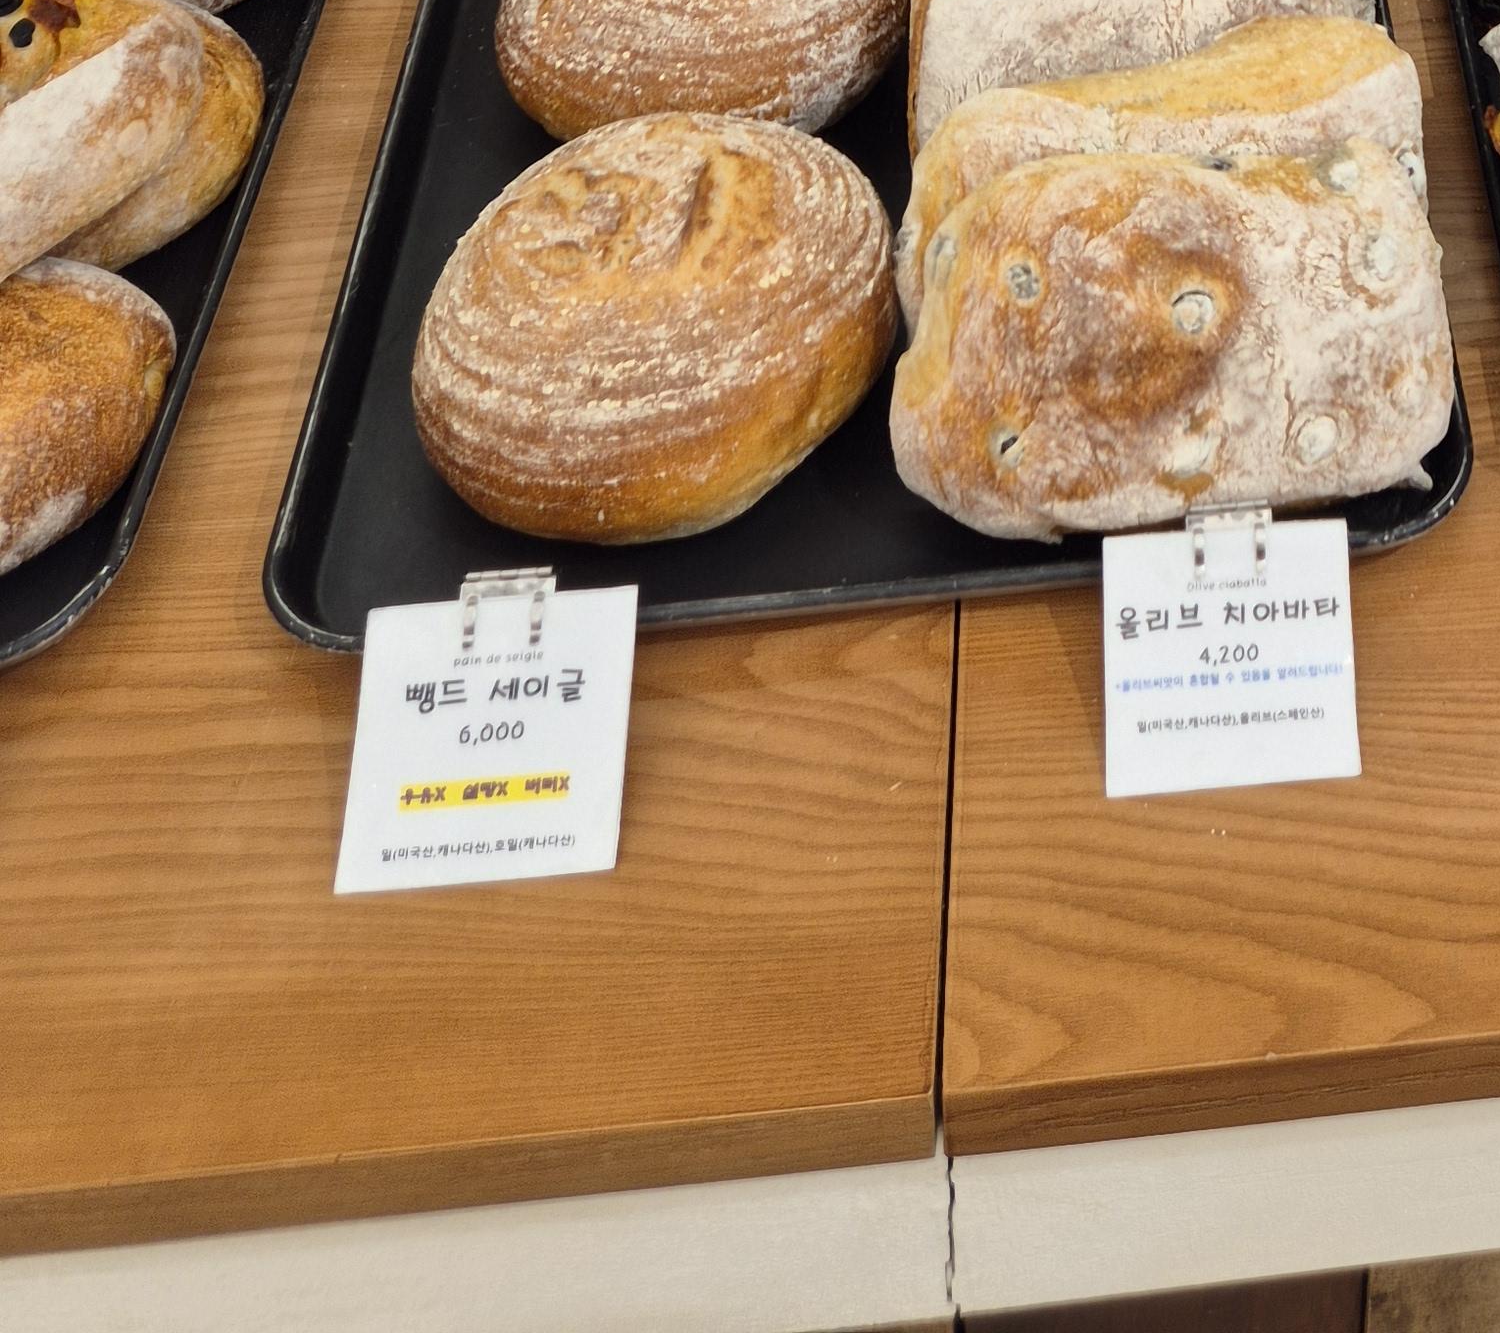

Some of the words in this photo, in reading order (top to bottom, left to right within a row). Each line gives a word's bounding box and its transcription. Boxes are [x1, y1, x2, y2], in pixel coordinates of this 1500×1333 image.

[1116, 603, 1203, 640] 올리브
[1223, 597, 1340, 626] 치아바타
[1199, 643, 1259, 667] 4,200
[406, 679, 468, 714] 뺑드
[489, 668, 586, 703] 세이글
[459, 720, 525, 746] 6,000
